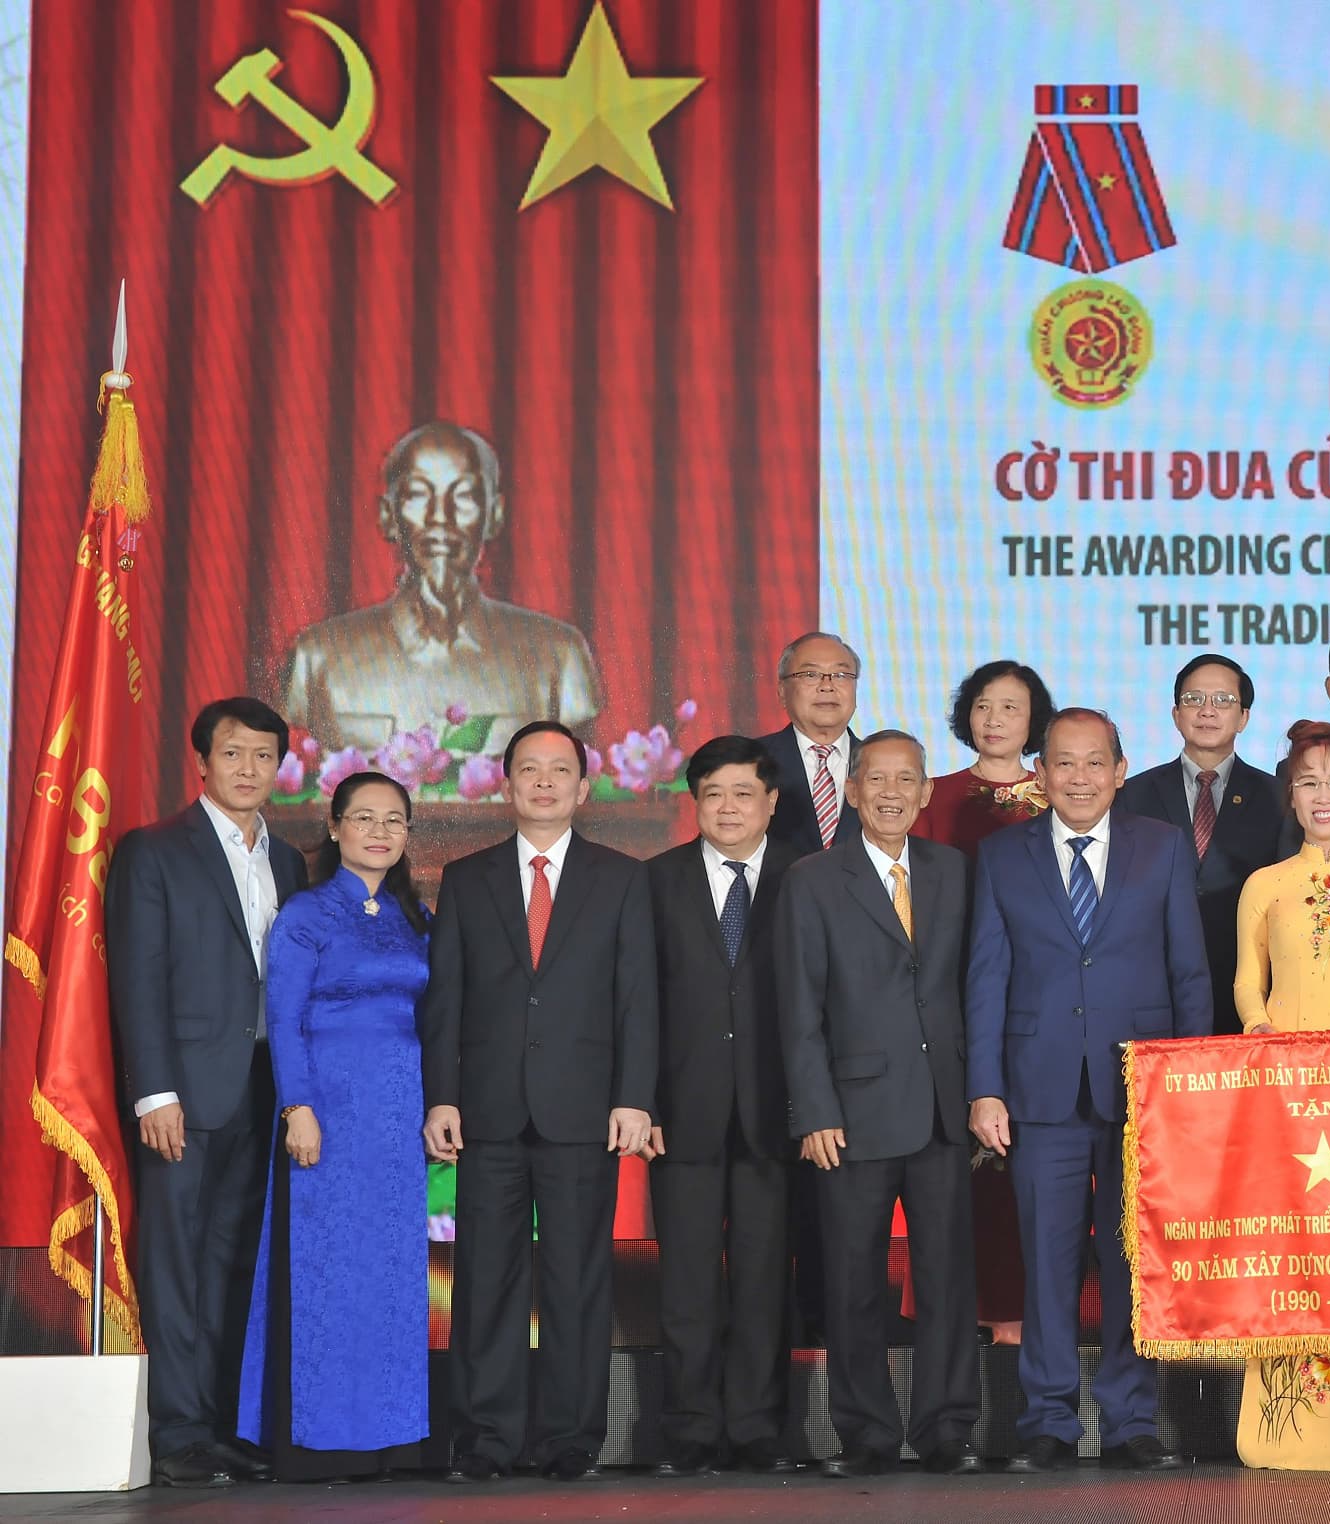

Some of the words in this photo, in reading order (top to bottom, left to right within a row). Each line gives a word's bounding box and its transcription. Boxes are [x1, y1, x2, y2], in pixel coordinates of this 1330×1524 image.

[995, 440, 1061, 501] CỜ
[1069, 451, 1155, 500] THI
[1167, 450, 1275, 500] ĐUA
[1002, 535, 1074, 577] THE
[1081, 534, 1291, 577] AWARDING
[1138, 604, 1209, 645] THE
[1165, 1067, 1183, 1093] ỦY
[1187, 1072, 1216, 1092] BAN
[1221, 1066, 1260, 1089] NHÂN
[1265, 1063, 1294, 1086] DÂN
[1164, 1217, 1196, 1240] NGÂN
[1200, 1216, 1231, 1239] HÀNG
[1234, 1216, 1267, 1236] TMCP
[1271, 1210, 1301, 1234] PHÁT
[1171, 1260, 1192, 1282] 30
[1198, 1253, 1238, 1280] NĂM
[1244, 1250, 1282, 1277] XÂY
[1271, 1288, 1321, 1316] (1990
